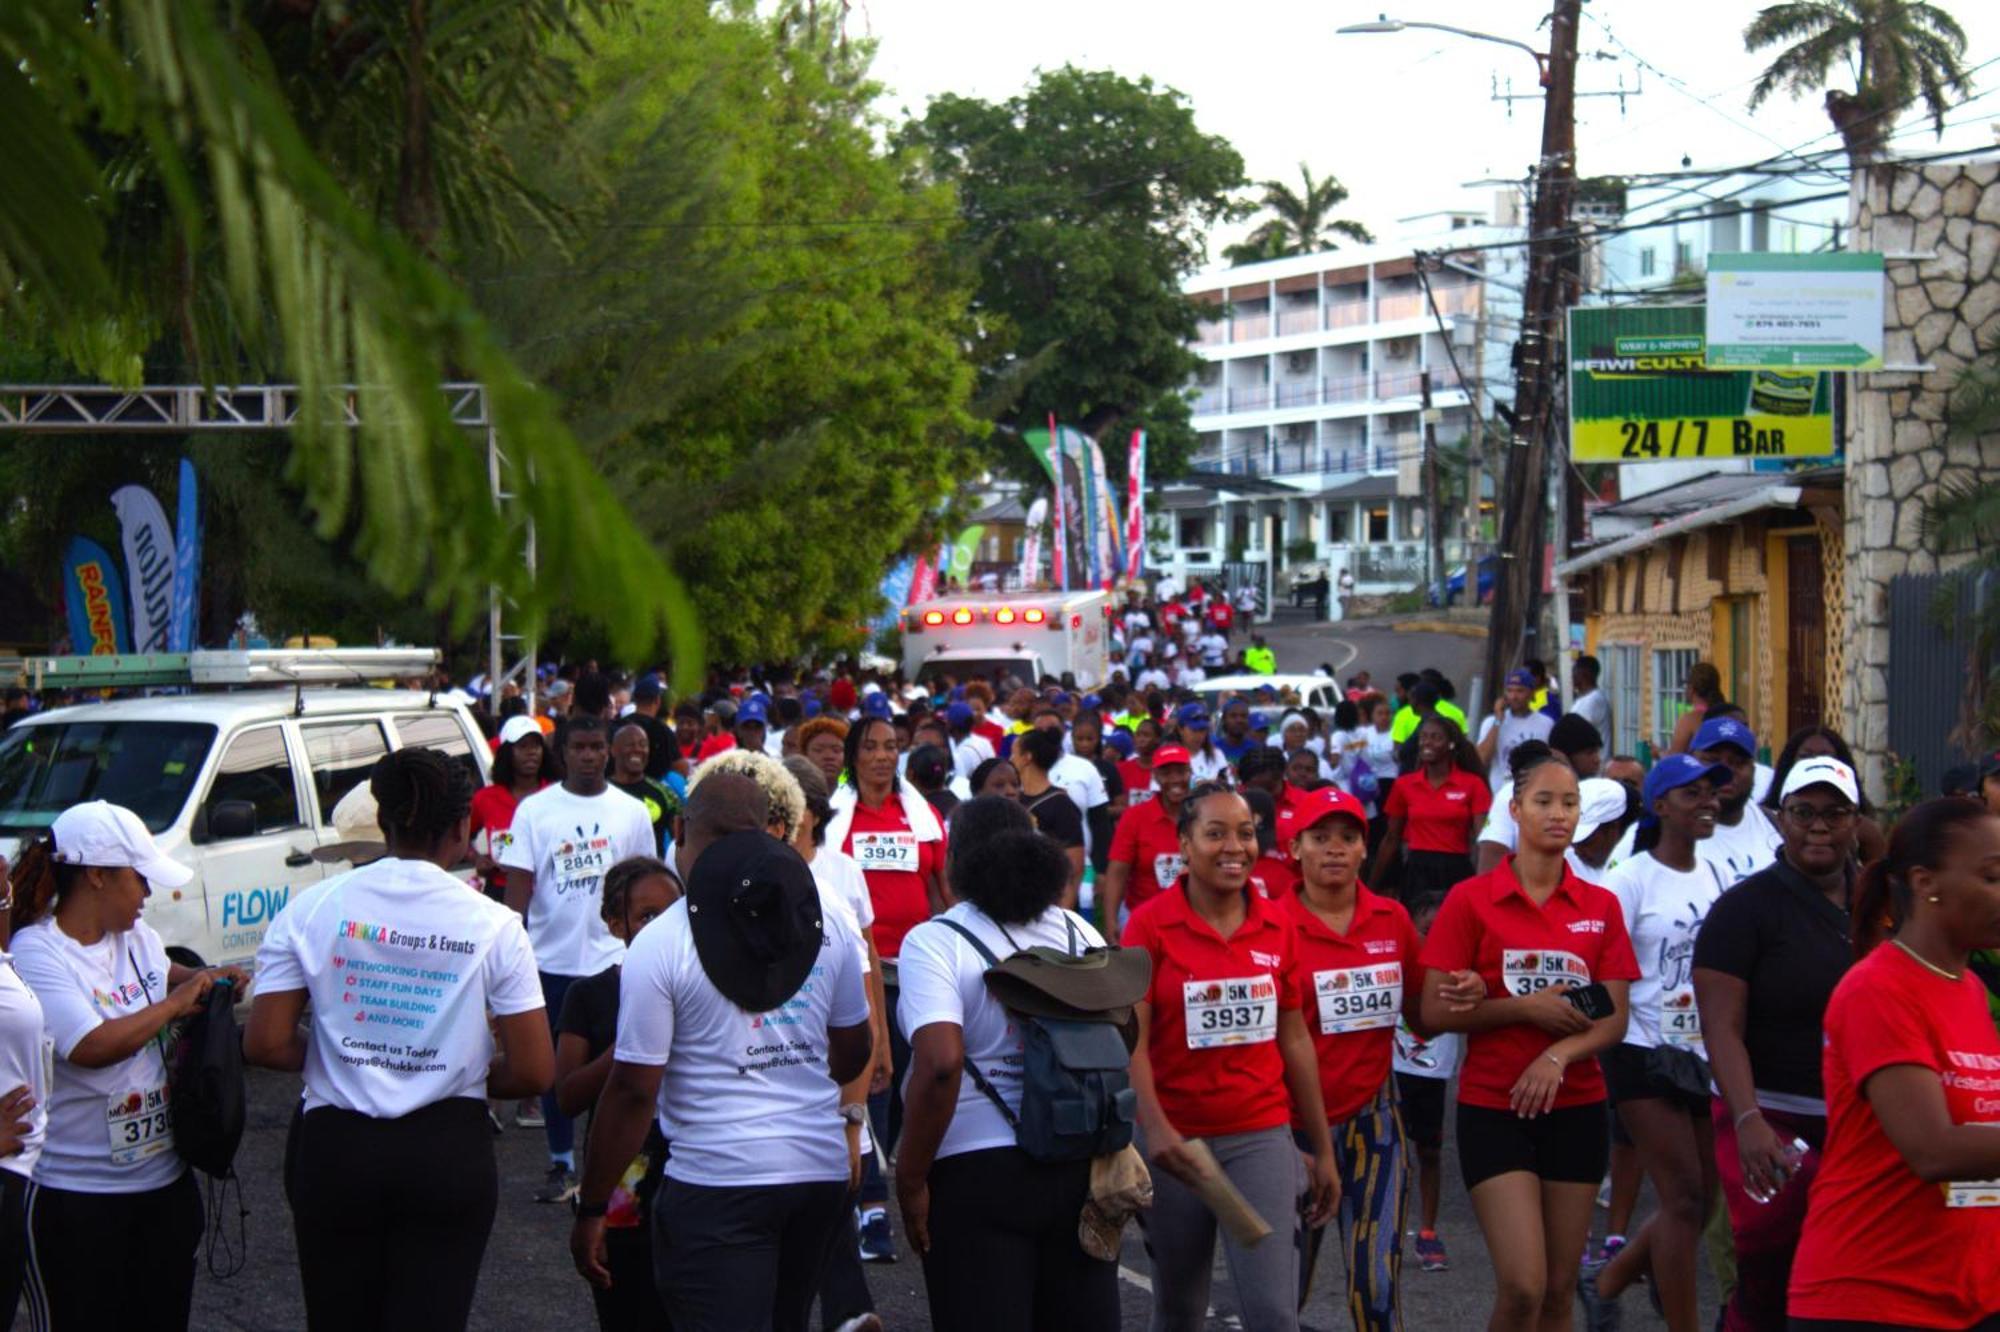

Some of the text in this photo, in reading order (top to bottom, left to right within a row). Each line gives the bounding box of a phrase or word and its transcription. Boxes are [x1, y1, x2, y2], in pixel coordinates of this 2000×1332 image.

[1660, 340, 1699, 350] NEPHEW
[563, 852, 603, 871] 2841
[864, 847, 907, 859] 3947
[223, 885, 289, 929] FLOW
[339, 919, 476, 955] CHUKKA Groups & Events
[346, 959, 459, 983] NETWORKING EVENTS
[1546, 957, 1564, 971] 5K
[358, 977, 443, 998] STAFF FUN DAYS
[1355, 972, 1375, 988] 5K
[1375, 969, 1400, 985] RUN
[1229, 984, 1248, 1000] 5K
[1251, 982, 1273, 999] RUN
[360, 995, 437, 1014] TEAM BUILDING
[1333, 991, 1393, 1016] 3944
[366, 1013, 390, 1025] AND
[1201, 1004, 1265, 1030] 3937
[341, 1036, 439, 1059] Contact us Today
